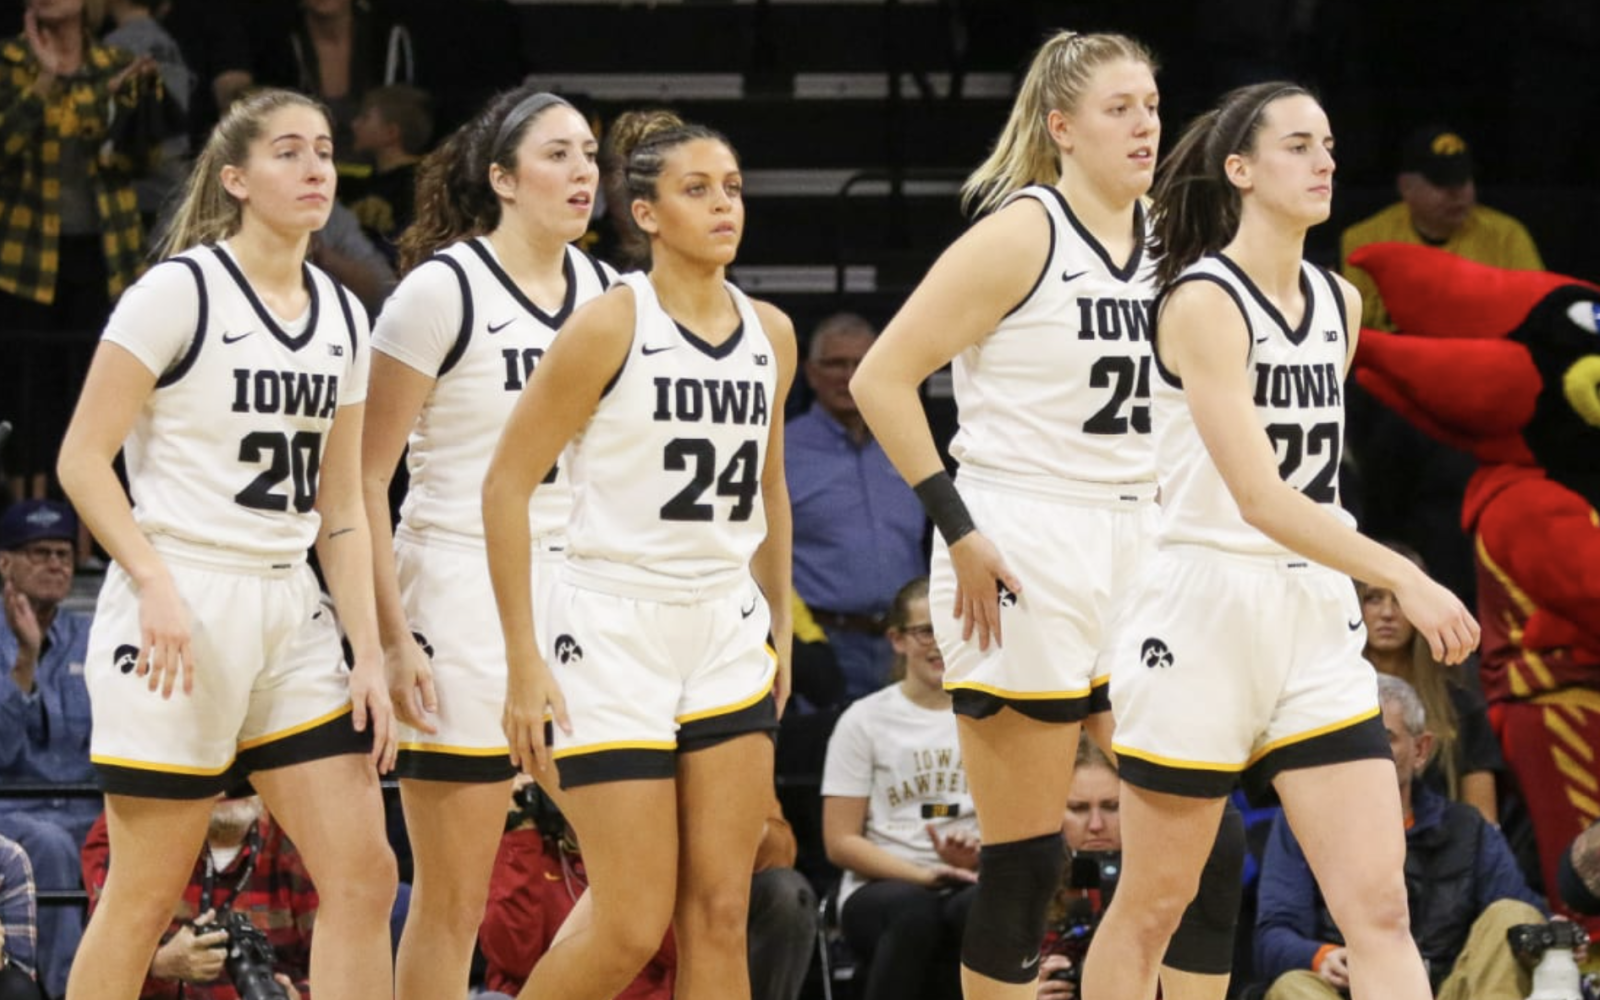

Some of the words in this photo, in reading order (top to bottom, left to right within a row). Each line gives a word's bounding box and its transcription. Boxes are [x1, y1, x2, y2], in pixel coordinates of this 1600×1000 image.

[1076, 297, 1152, 342] IOW
[232, 369, 338, 419] IOWA
[653, 377, 767, 425] IOWA
[1253, 362, 1341, 408] IOWA
[234, 431, 322, 514] 20
[660, 437, 759, 521] 24
